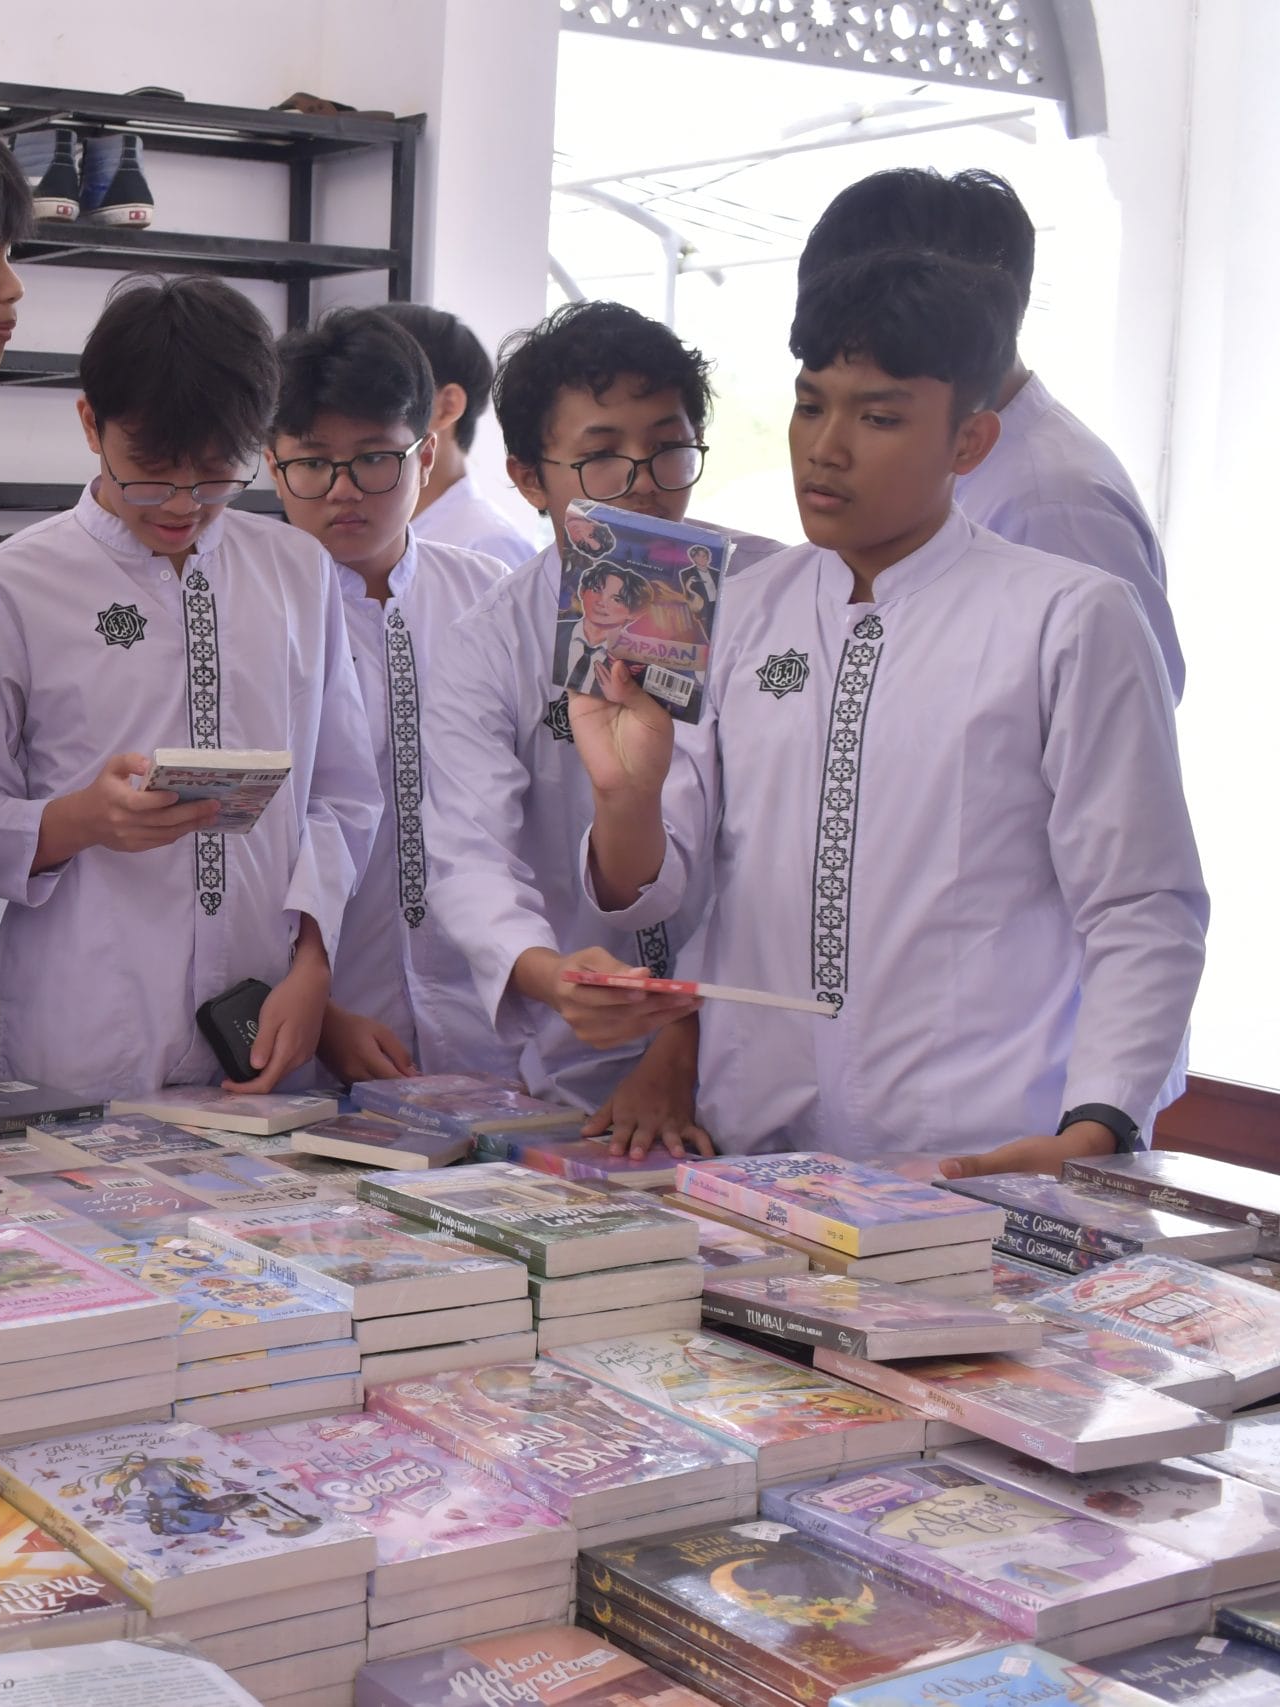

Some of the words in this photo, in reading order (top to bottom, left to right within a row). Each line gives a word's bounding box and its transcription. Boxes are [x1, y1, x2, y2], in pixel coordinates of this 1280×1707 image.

[746, 1309, 784, 1332] TUMBAL
[0, 1594, 68, 1616] LUZ
[448, 1650, 555, 1699] Mahen
